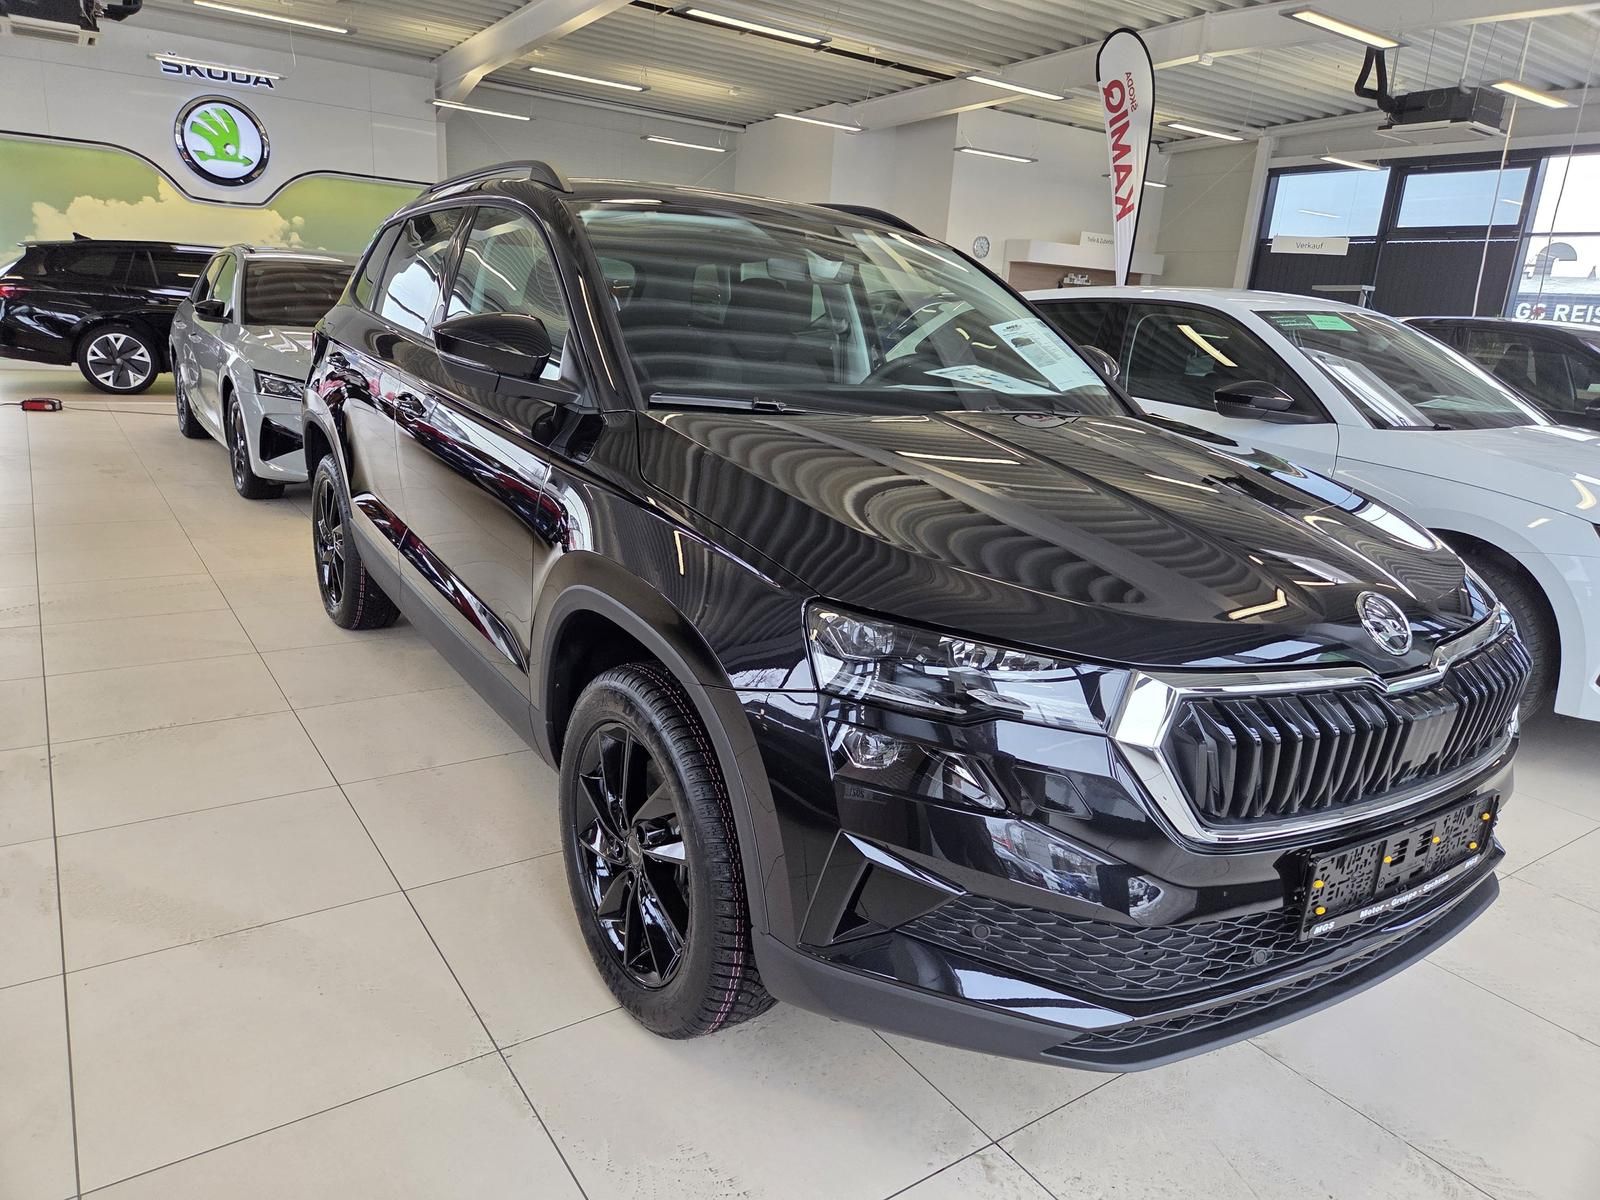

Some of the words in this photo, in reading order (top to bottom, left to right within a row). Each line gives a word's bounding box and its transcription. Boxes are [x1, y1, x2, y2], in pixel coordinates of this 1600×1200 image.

[161, 51, 274, 88] ŠKODA
[1296, 240, 1324, 250] Verkauf
[1313, 921, 1336, 935] MGS
[1359, 904, 1384, 918] Motor
[1391, 890, 1418, 906] Gruppe
[1422, 874, 1449, 891] Sachsen
